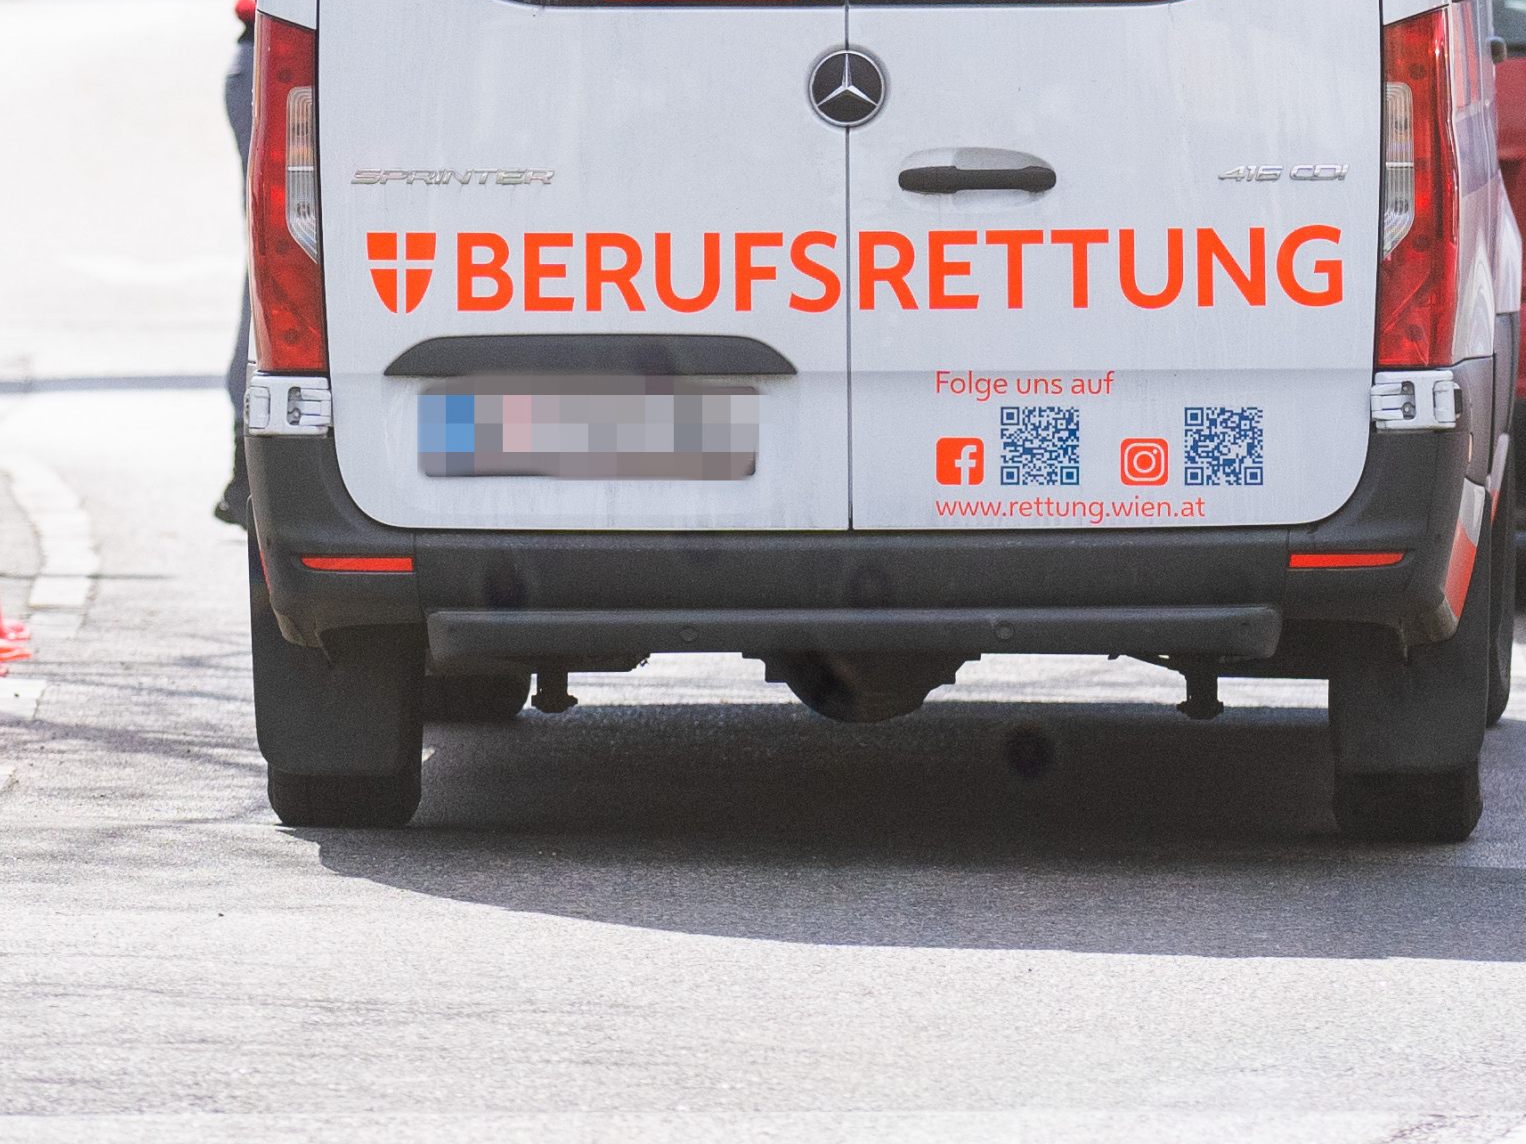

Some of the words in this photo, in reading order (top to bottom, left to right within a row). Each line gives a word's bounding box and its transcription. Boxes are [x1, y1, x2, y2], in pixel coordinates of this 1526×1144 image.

[351, 168, 556, 185] SPRINTER
[1290, 164, 1349, 181] CDI
[456, 225, 1344, 313] BERUFSRETTUNG
[935, 370, 1008, 401] Folge
[1016, 377, 1063, 395] uns
[1070, 370, 1115, 395] auf
[935, 497, 1206, 524] www.rettung.wien.at
